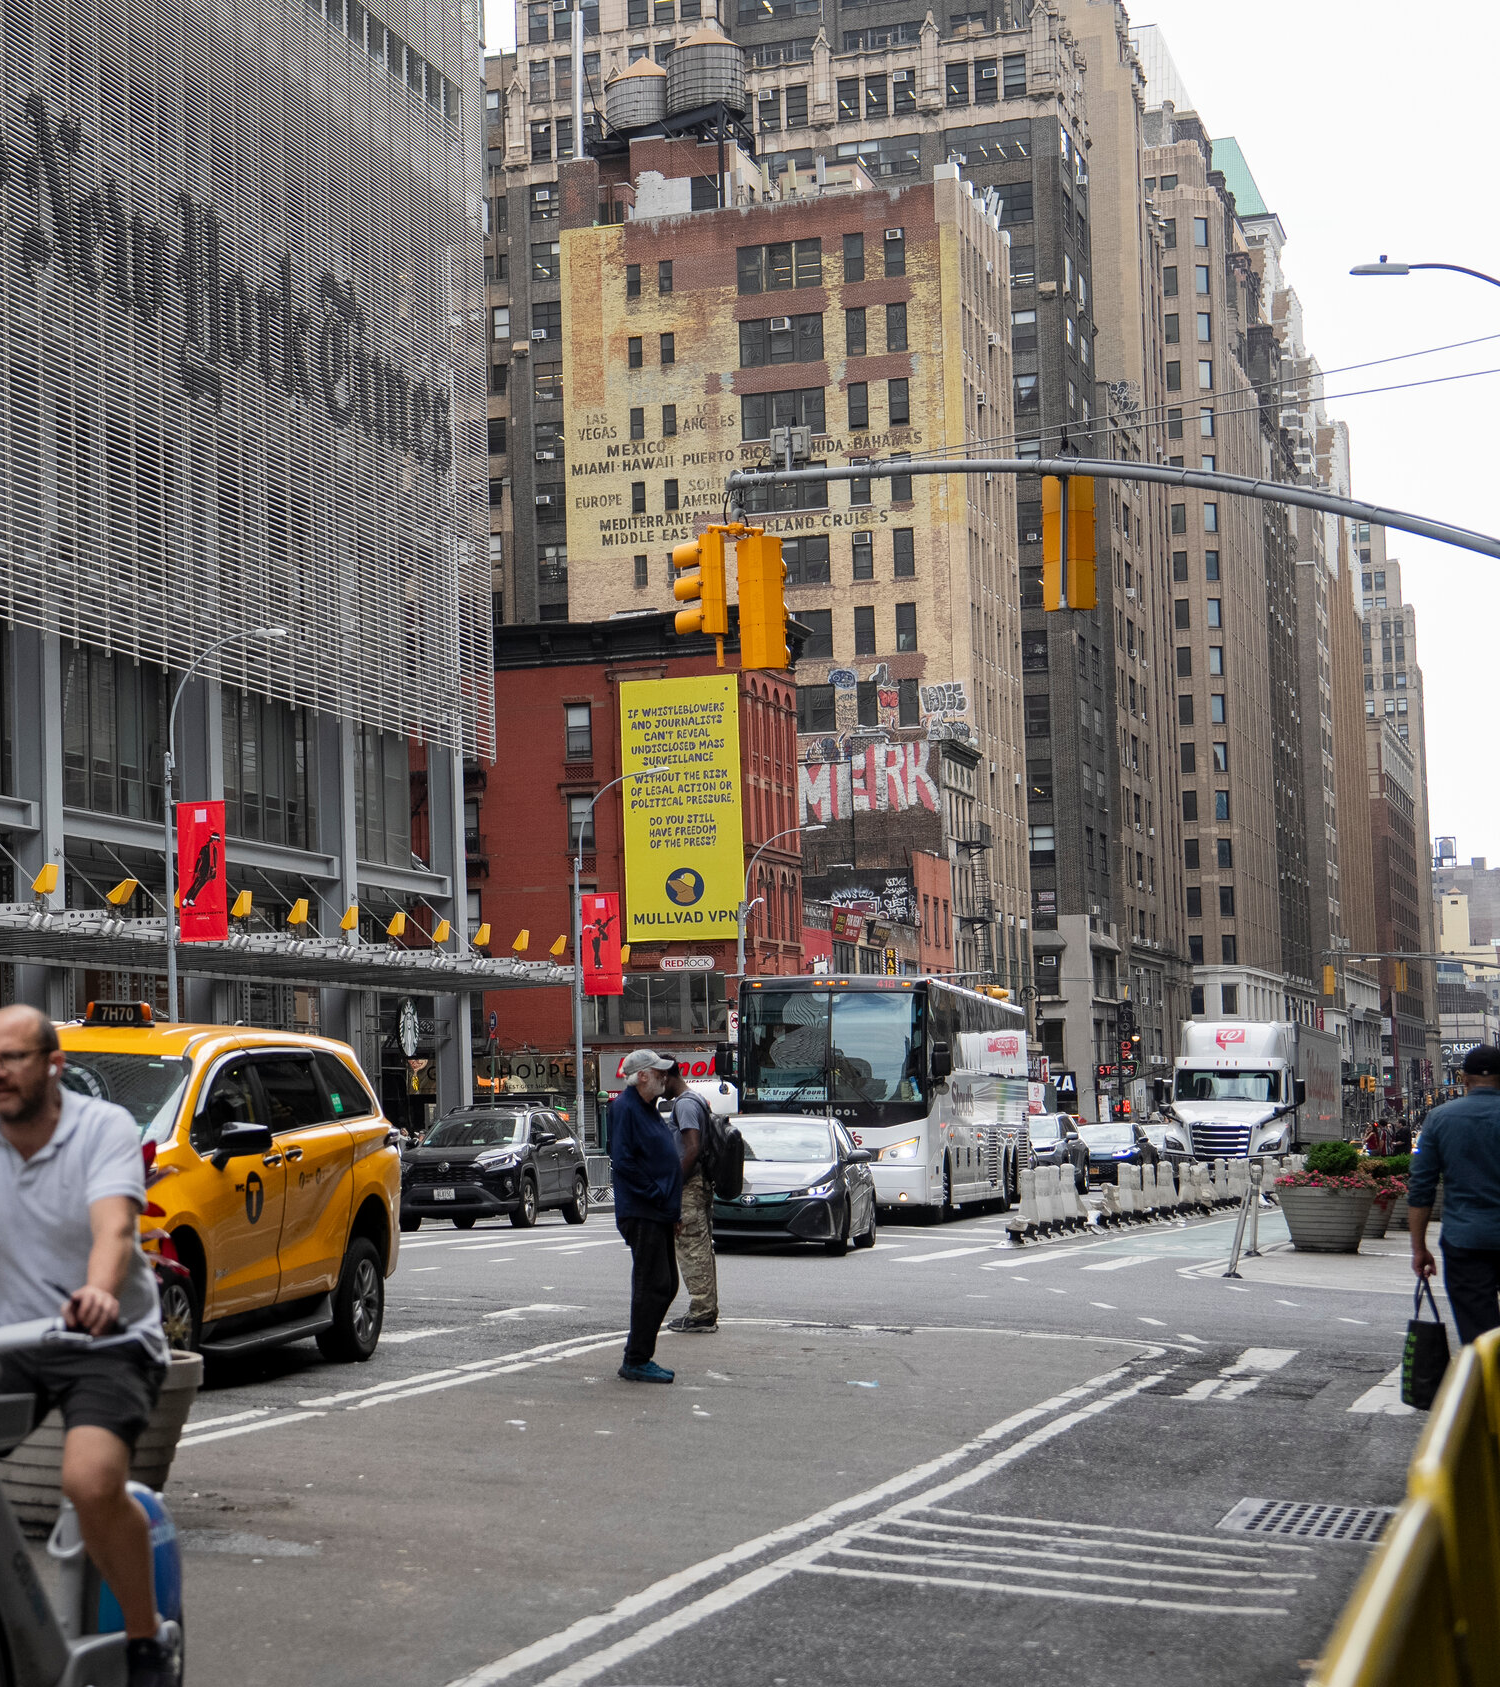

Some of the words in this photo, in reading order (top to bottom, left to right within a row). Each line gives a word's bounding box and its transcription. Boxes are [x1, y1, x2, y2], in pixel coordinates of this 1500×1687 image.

[21, 90, 168, 321] New
[175, 191, 314, 414] York
[321, 271, 452, 478] Times
[586, 413, 608, 425] LAS
[577, 426, 618, 441] VEGAS
[606, 440, 667, 458] MEXICO
[571, 462, 615, 476] MIAMI
[622, 455, 674, 472] HAWAII
[682, 449, 735, 467] PUERTO
[575, 493, 623, 509] EUROPE
[601, 530, 654, 546] MIDDLE
[627, 709, 639, 719] IF
[642, 702, 725, 718] WHISTLEBLOWERS
[631, 720, 652, 730] AND
[654, 714, 722, 729] JOURNALISTS
[644, 730, 674, 742] CAN'T
[677, 727, 711, 739] REVEAL
[631, 741, 696, 755] UNDISCLOSED
[699, 738, 725, 750] MASS
[642, 751, 714, 766] SURVEILLANCE
[634, 771, 681, 784] WITHOUT
[684, 770, 700, 780] THE
[703, 769, 728, 779] RISK
[797, 740, 942, 826] MERK
[631, 787, 643, 797] OF
[645, 785, 675, 796] LEGAL
[677, 782, 717, 793] ACTION
[719, 781, 733, 790] OR
[631, 796, 684, 809] POLITICAL
[686, 793, 735, 805] PRESSURE,
[649, 817, 663, 827] DO
[666, 815, 684, 825] YOU
[687, 813, 715, 824] STILL
[649, 827, 673, 838] HAVE
[675, 824, 717, 836] FREEDOM
[650, 839, 662, 849] OF
[664, 838, 681, 848] THE
[684, 835, 717, 847] PRESS?
[633, 911, 704, 925] MULLVAD
[708, 909, 738, 922] VPN
[886, 949, 896, 976] BAR
[876, 979, 896, 989] 418
[101, 1006, 134, 1021] 7H70
